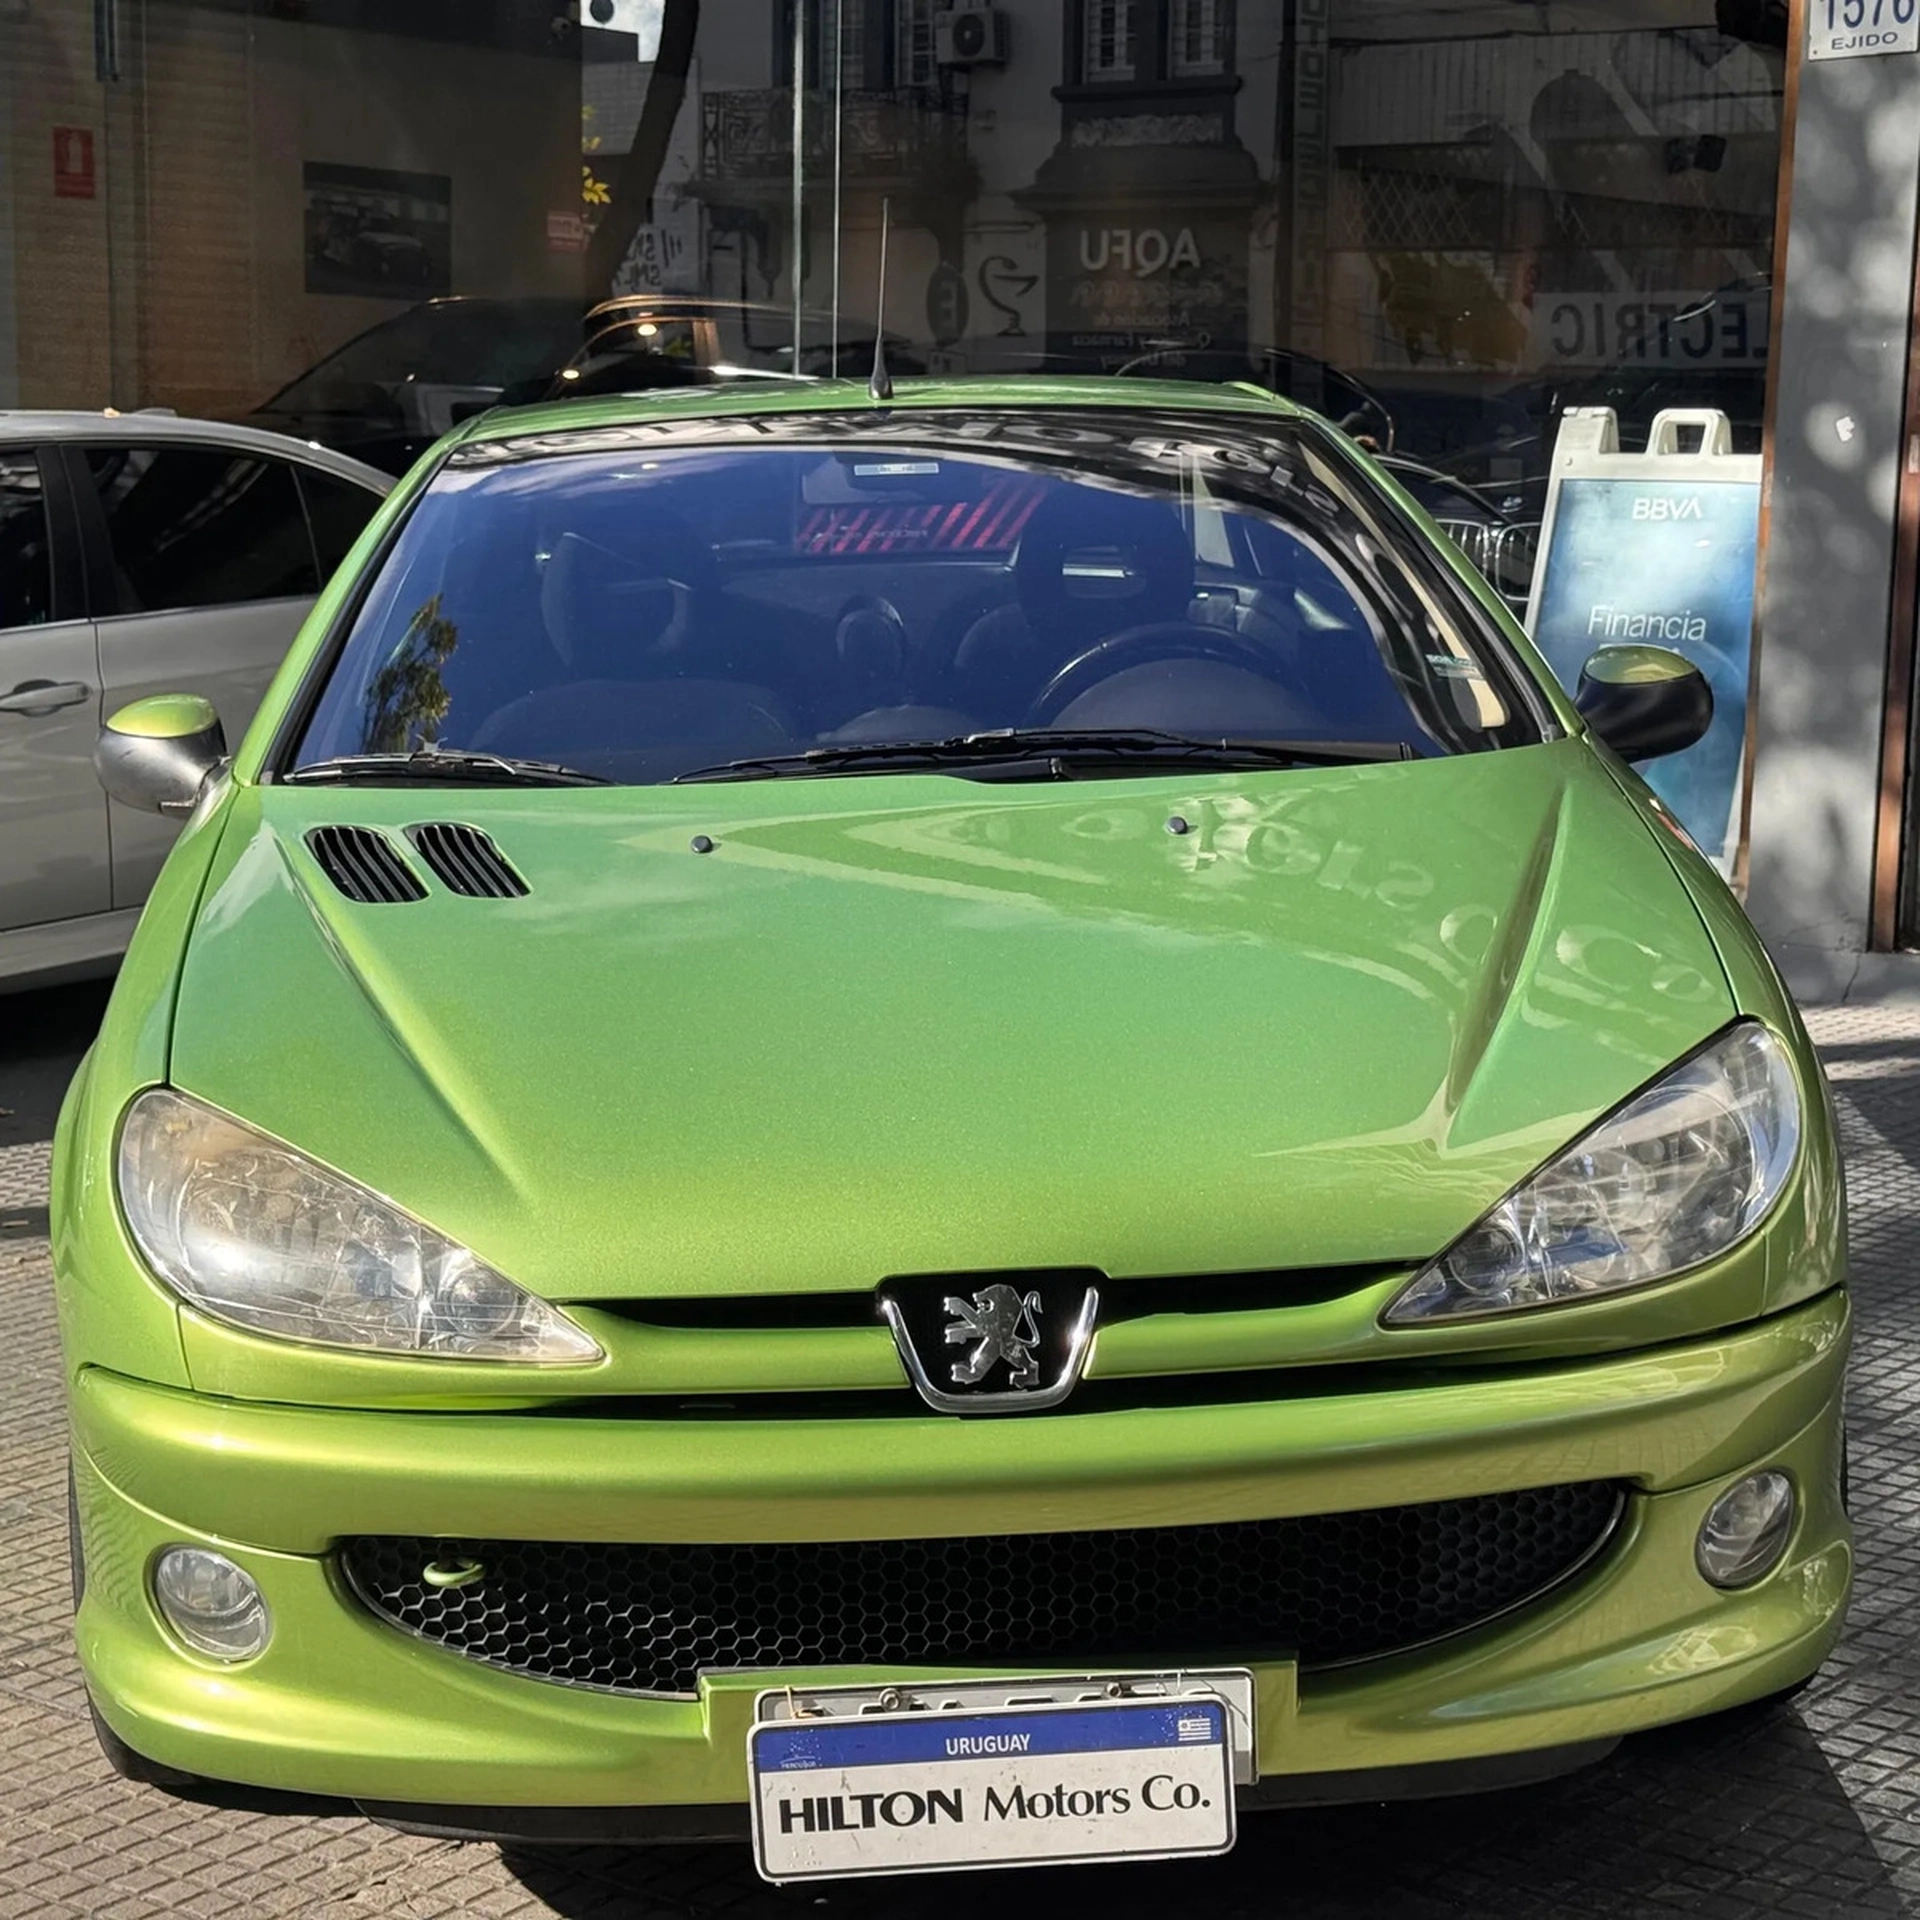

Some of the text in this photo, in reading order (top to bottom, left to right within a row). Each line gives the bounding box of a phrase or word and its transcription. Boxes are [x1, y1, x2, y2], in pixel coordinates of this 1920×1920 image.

[1831, 32, 1898, 50] EJIDO
[1631, 496, 1703, 521] BBVA
[1587, 605, 1707, 642] Financia
[945, 1733, 1031, 1757] URUGUAY
[778, 1774, 1212, 1835] HILTON Motors Co.
